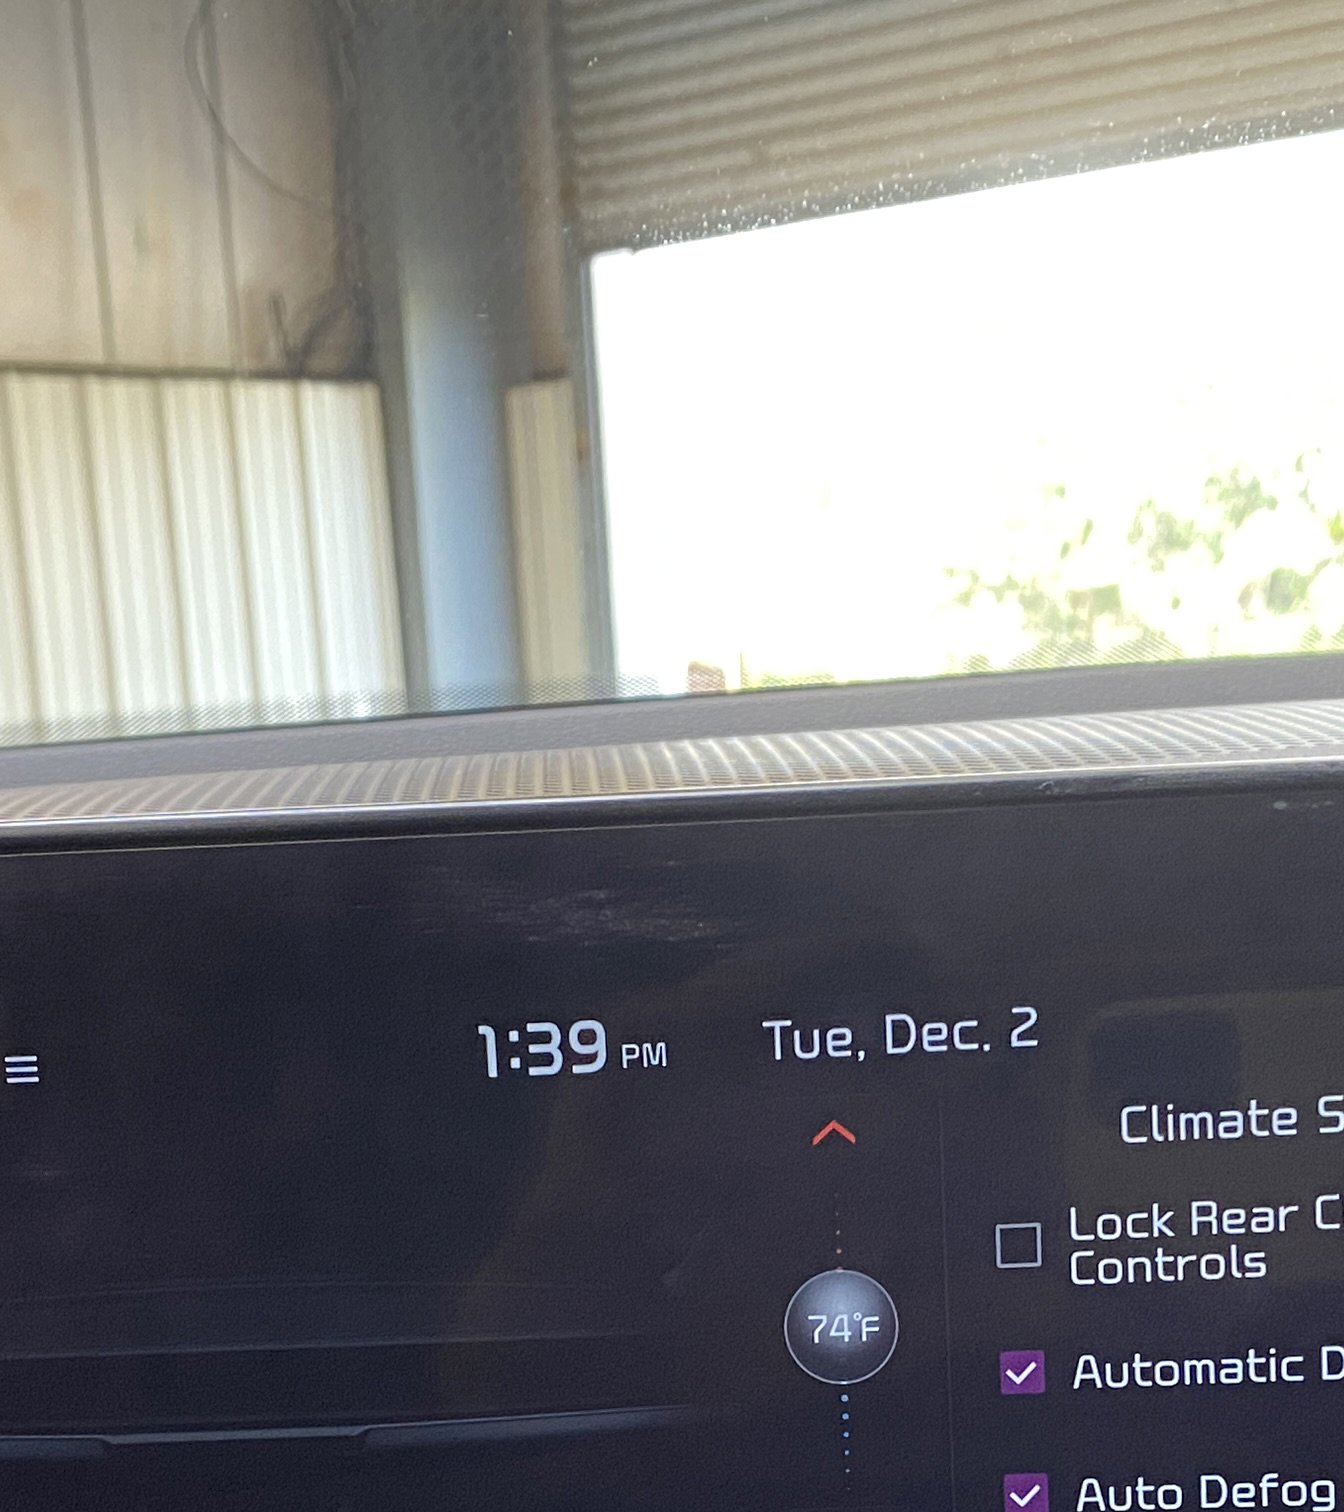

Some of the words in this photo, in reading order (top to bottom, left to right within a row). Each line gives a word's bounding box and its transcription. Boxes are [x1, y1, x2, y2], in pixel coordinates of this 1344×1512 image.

[478, 1020, 606, 1077] 1:39
[622, 1042, 666, 1068] PM
[762, 1020, 865, 1061] Tue,
[886, 1014, 990, 1054] Dec.
[1011, 1007, 1038, 1047] 2
[1121, 1100, 1297, 1143] Climate
[1069, 1202, 1176, 1241] Lock
[1192, 1201, 1299, 1235] Rear
[1071, 1244, 1266, 1285] Controls
[1073, 1348, 1304, 1389] Automatic
[1077, 1477, 1182, 1512] Auto
[1201, 1473, 1335, 1512] Defog
